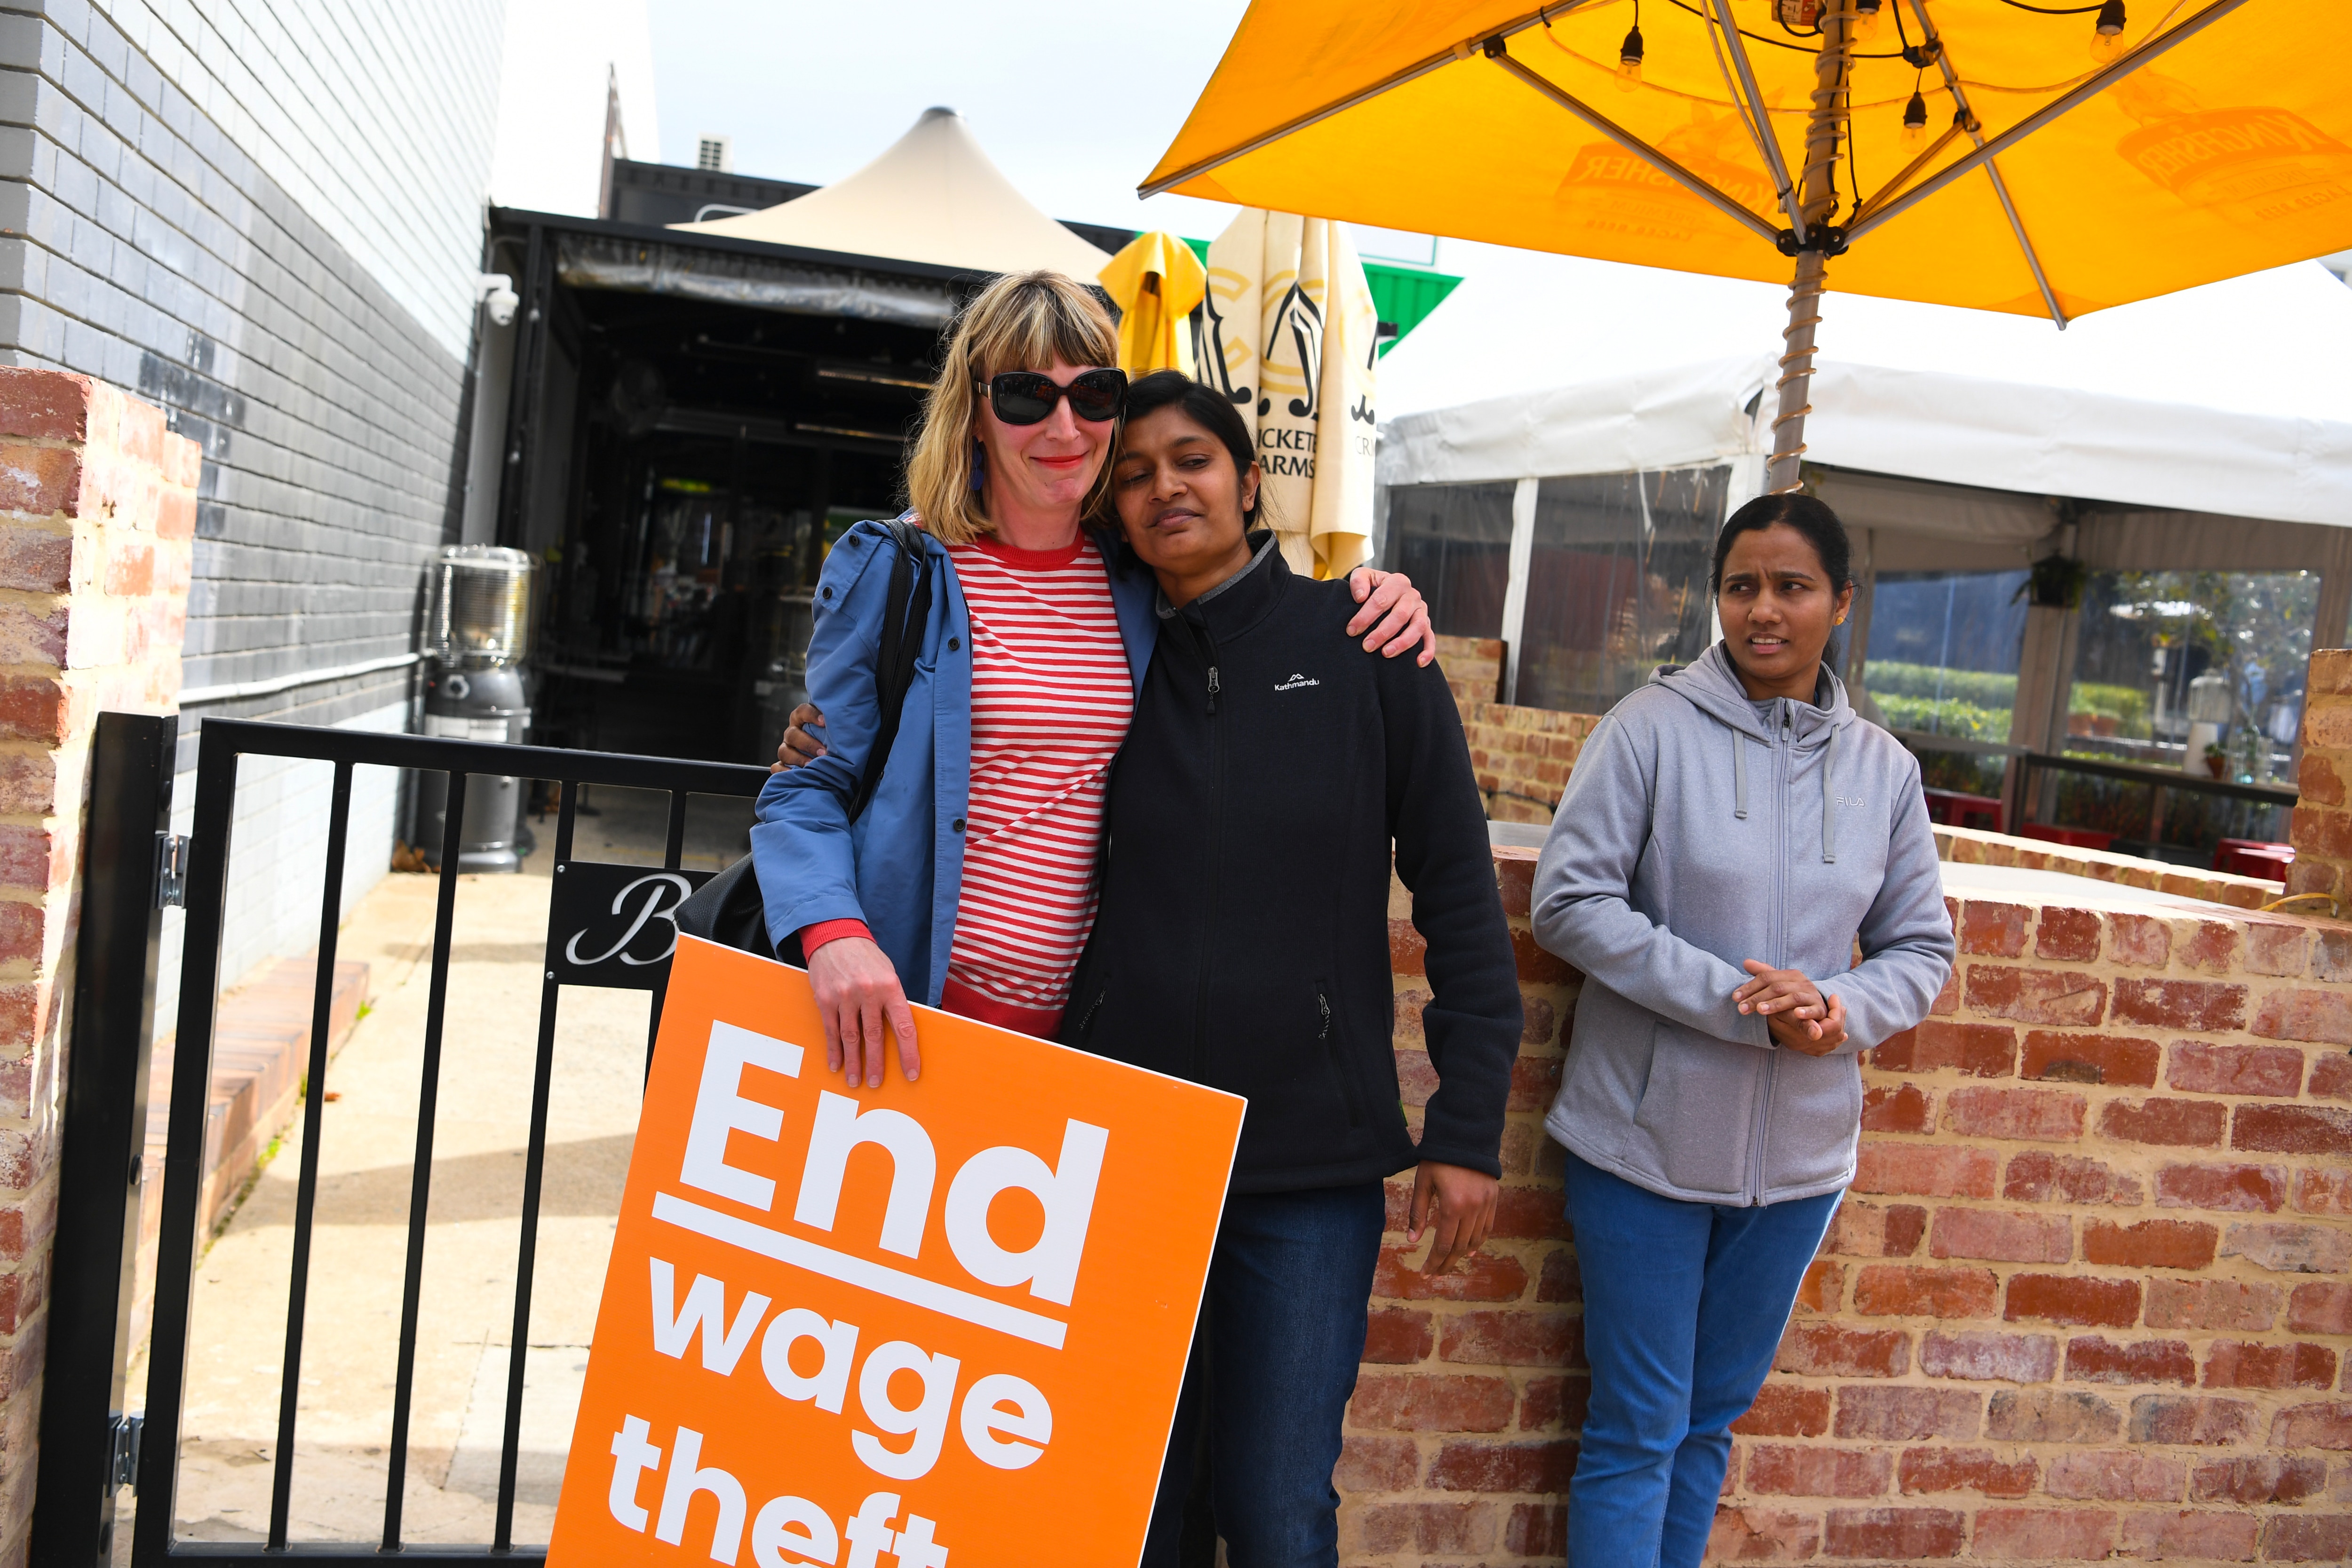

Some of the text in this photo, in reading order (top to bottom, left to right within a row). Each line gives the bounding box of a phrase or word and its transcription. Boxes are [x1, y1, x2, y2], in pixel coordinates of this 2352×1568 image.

[1274, 678, 1319, 691] Kathmandu
[1836, 796, 1865, 807] FILA
[680, 1019, 1109, 1307] End
[650, 1257, 1052, 1480] wage
